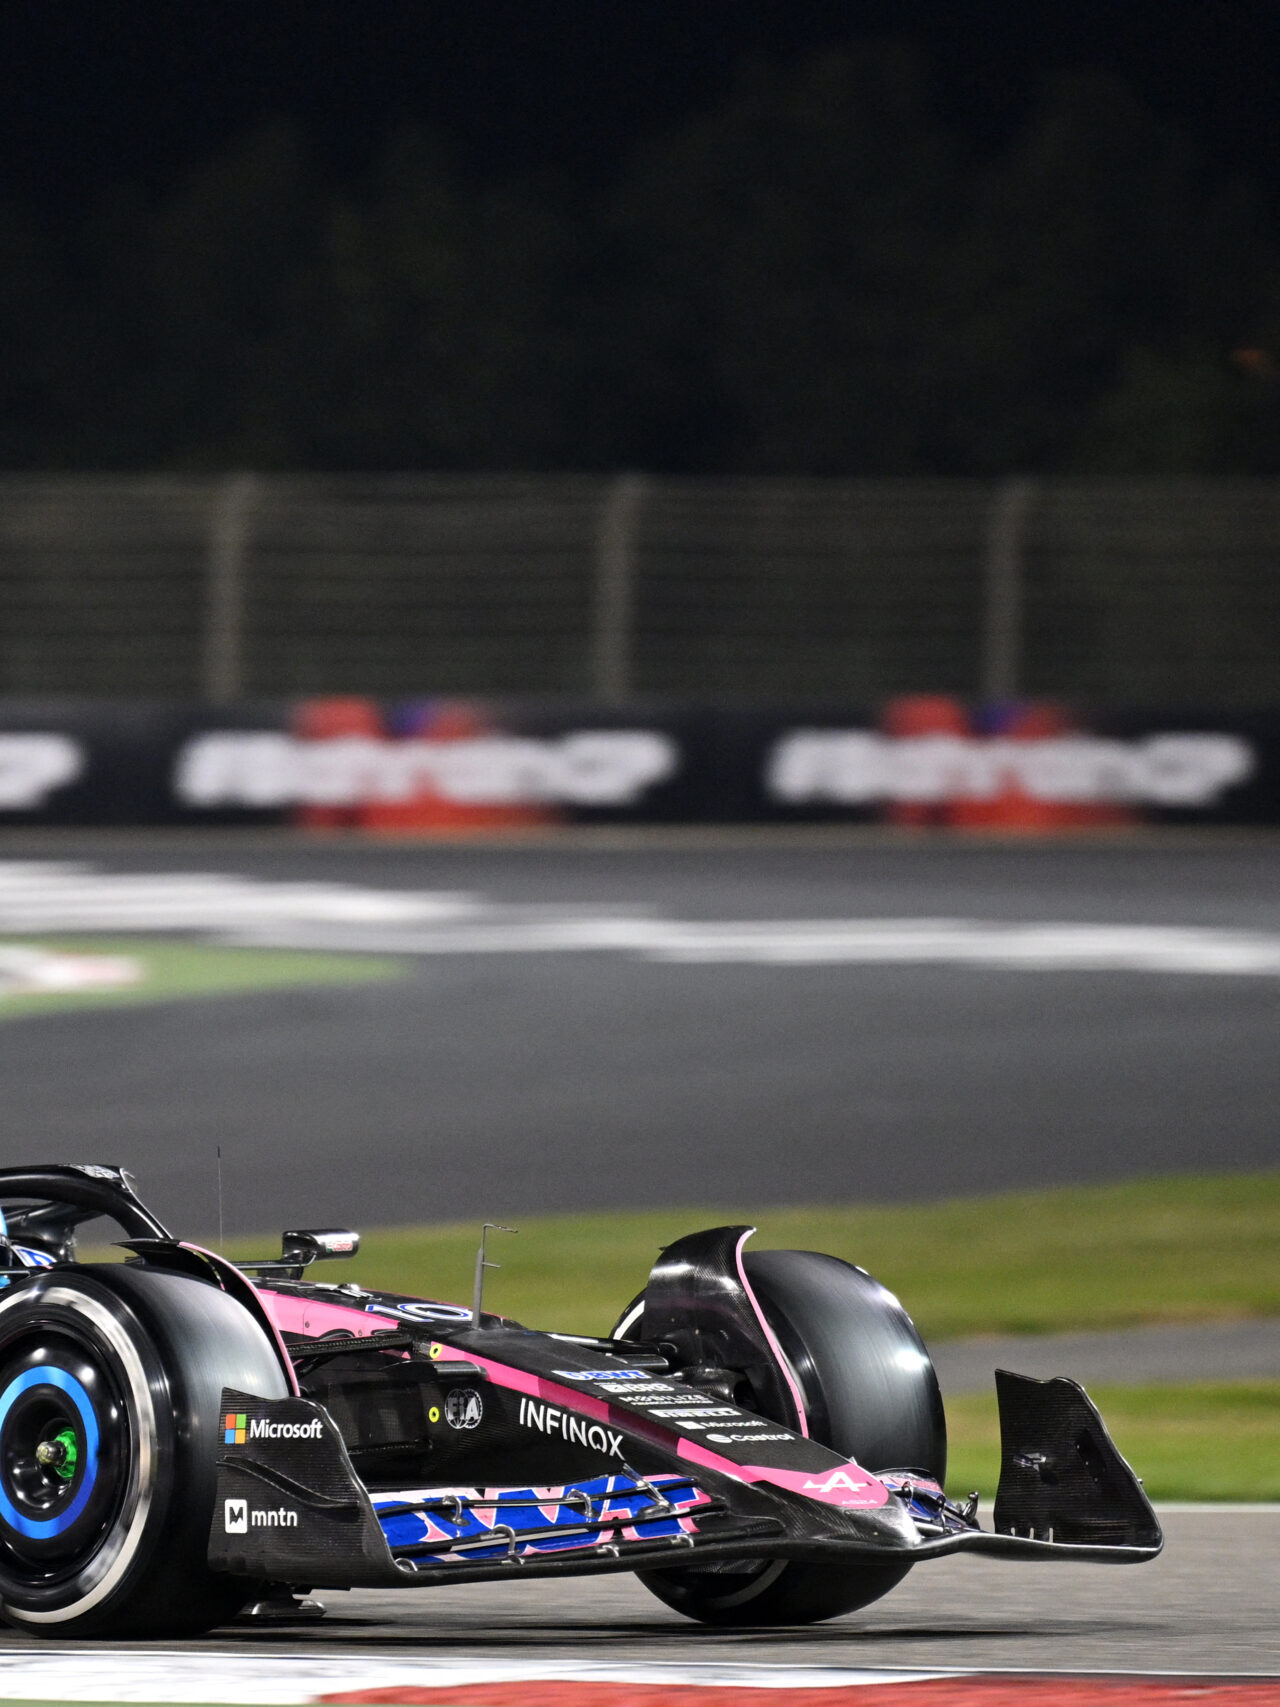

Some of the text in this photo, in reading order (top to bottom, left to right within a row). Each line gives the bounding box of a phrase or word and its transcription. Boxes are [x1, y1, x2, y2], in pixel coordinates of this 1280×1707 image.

[365, 1303, 474, 1322] 10
[250, 1418, 324, 1439] Microsoft
[730, 1433, 796, 1442] Castrol
[251, 1507, 298, 1527] mntn
